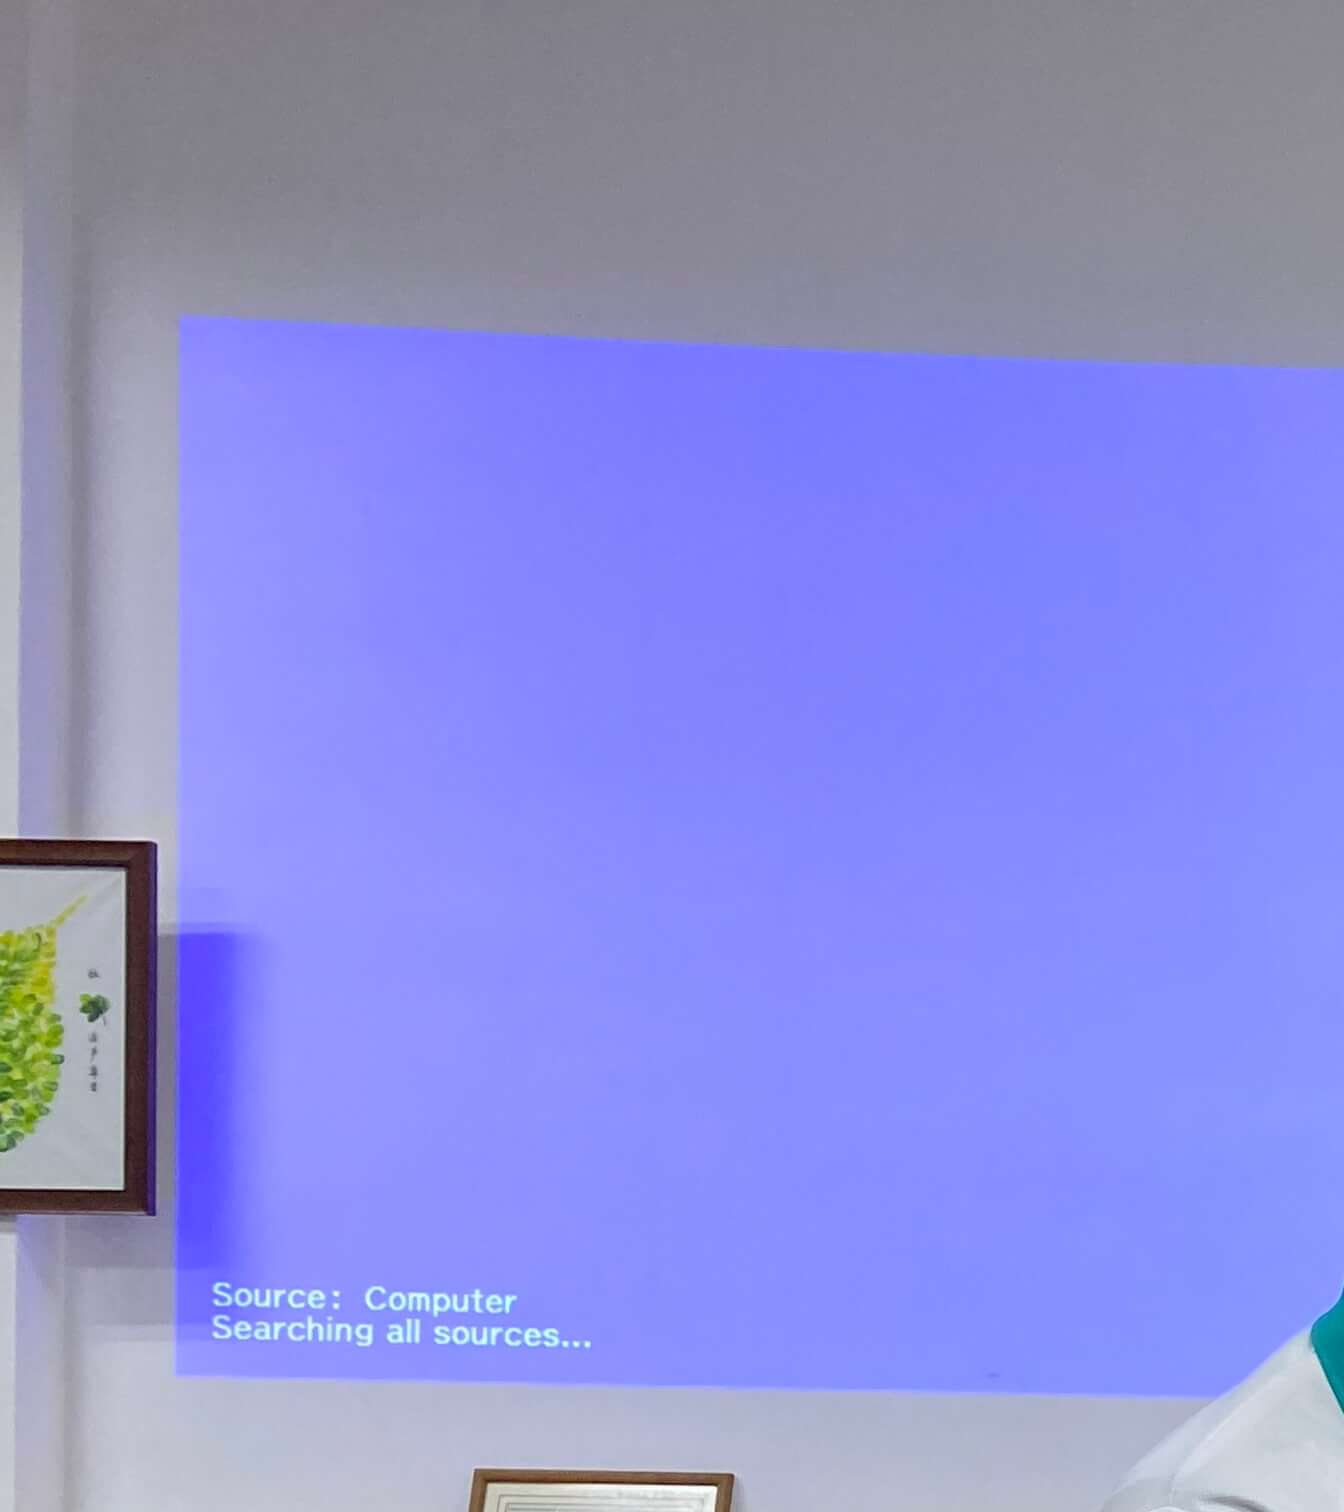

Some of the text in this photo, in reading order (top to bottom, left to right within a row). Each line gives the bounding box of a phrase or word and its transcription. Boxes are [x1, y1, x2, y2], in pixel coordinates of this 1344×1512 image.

[212, 1282, 518, 1316] Source: Computer
[211, 1314, 593, 1350] Searching all sources...
